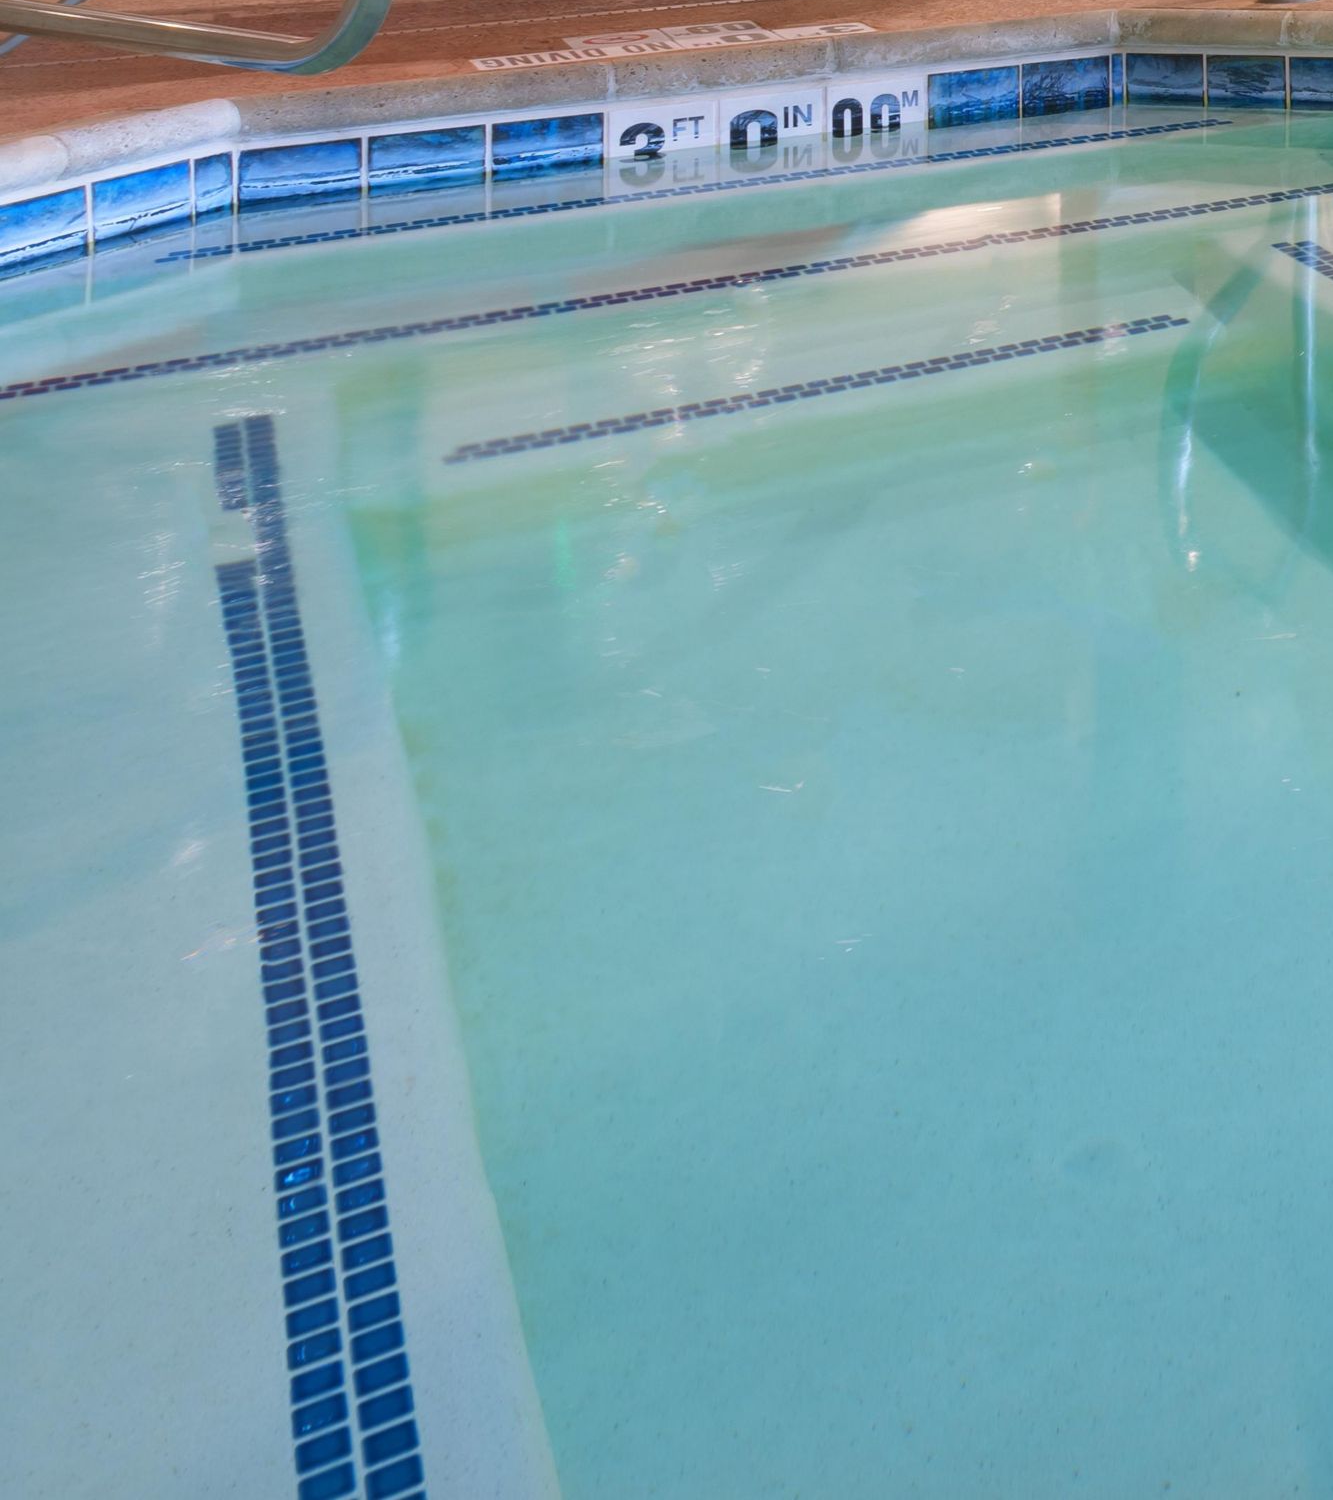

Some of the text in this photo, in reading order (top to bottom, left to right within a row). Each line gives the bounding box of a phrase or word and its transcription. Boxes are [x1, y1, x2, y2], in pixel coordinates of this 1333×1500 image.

[480, 41, 673, 68] NO DIVING
[672, 115, 705, 141] FT
[784, 103, 813, 129] IN
[901, 90, 919, 108] M
